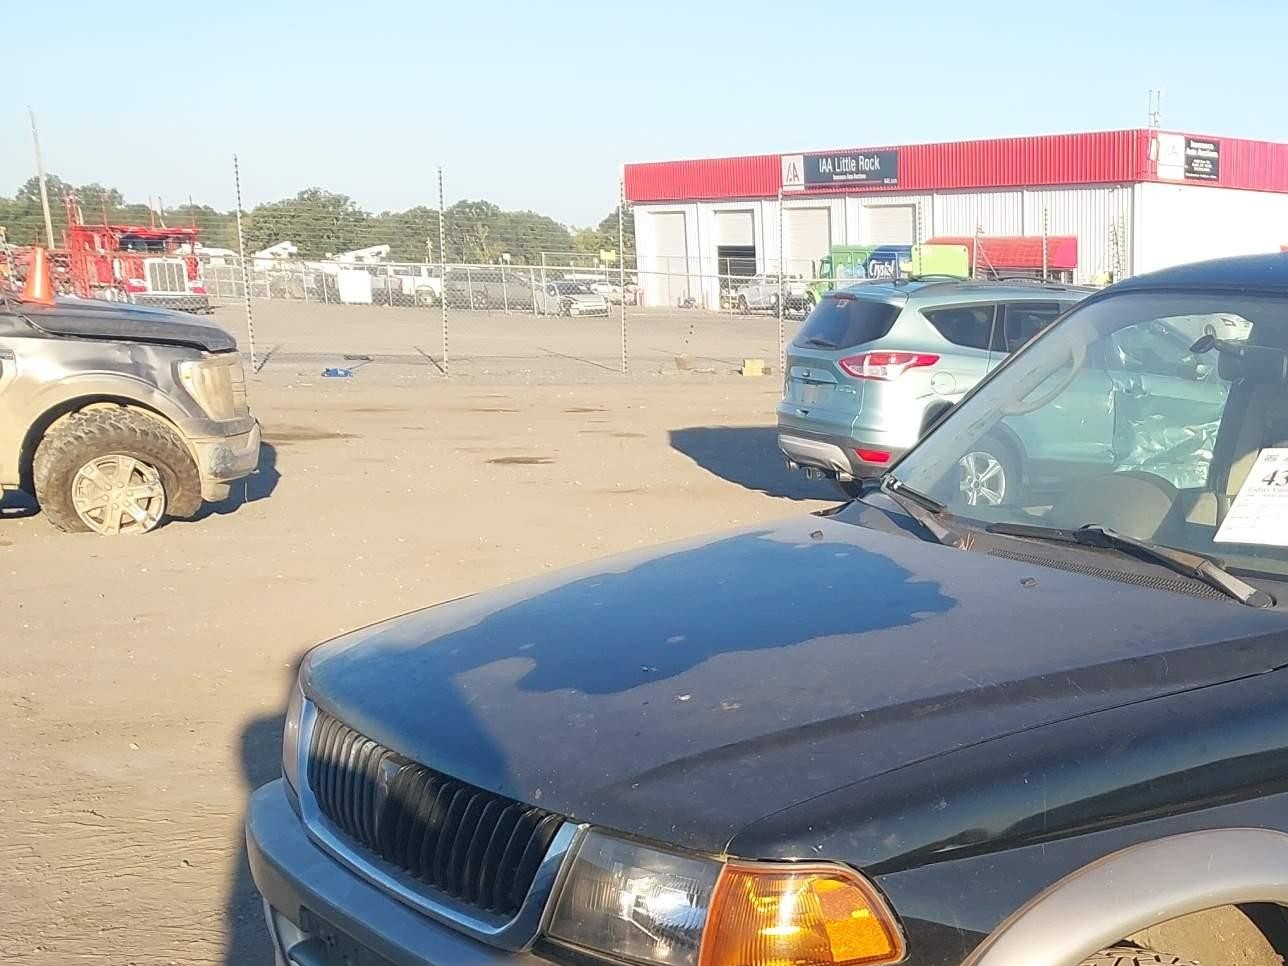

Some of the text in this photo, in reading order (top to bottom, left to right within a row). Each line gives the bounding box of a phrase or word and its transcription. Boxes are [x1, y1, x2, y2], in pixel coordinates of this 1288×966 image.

[819, 155, 880, 173] IAA Little Rock
